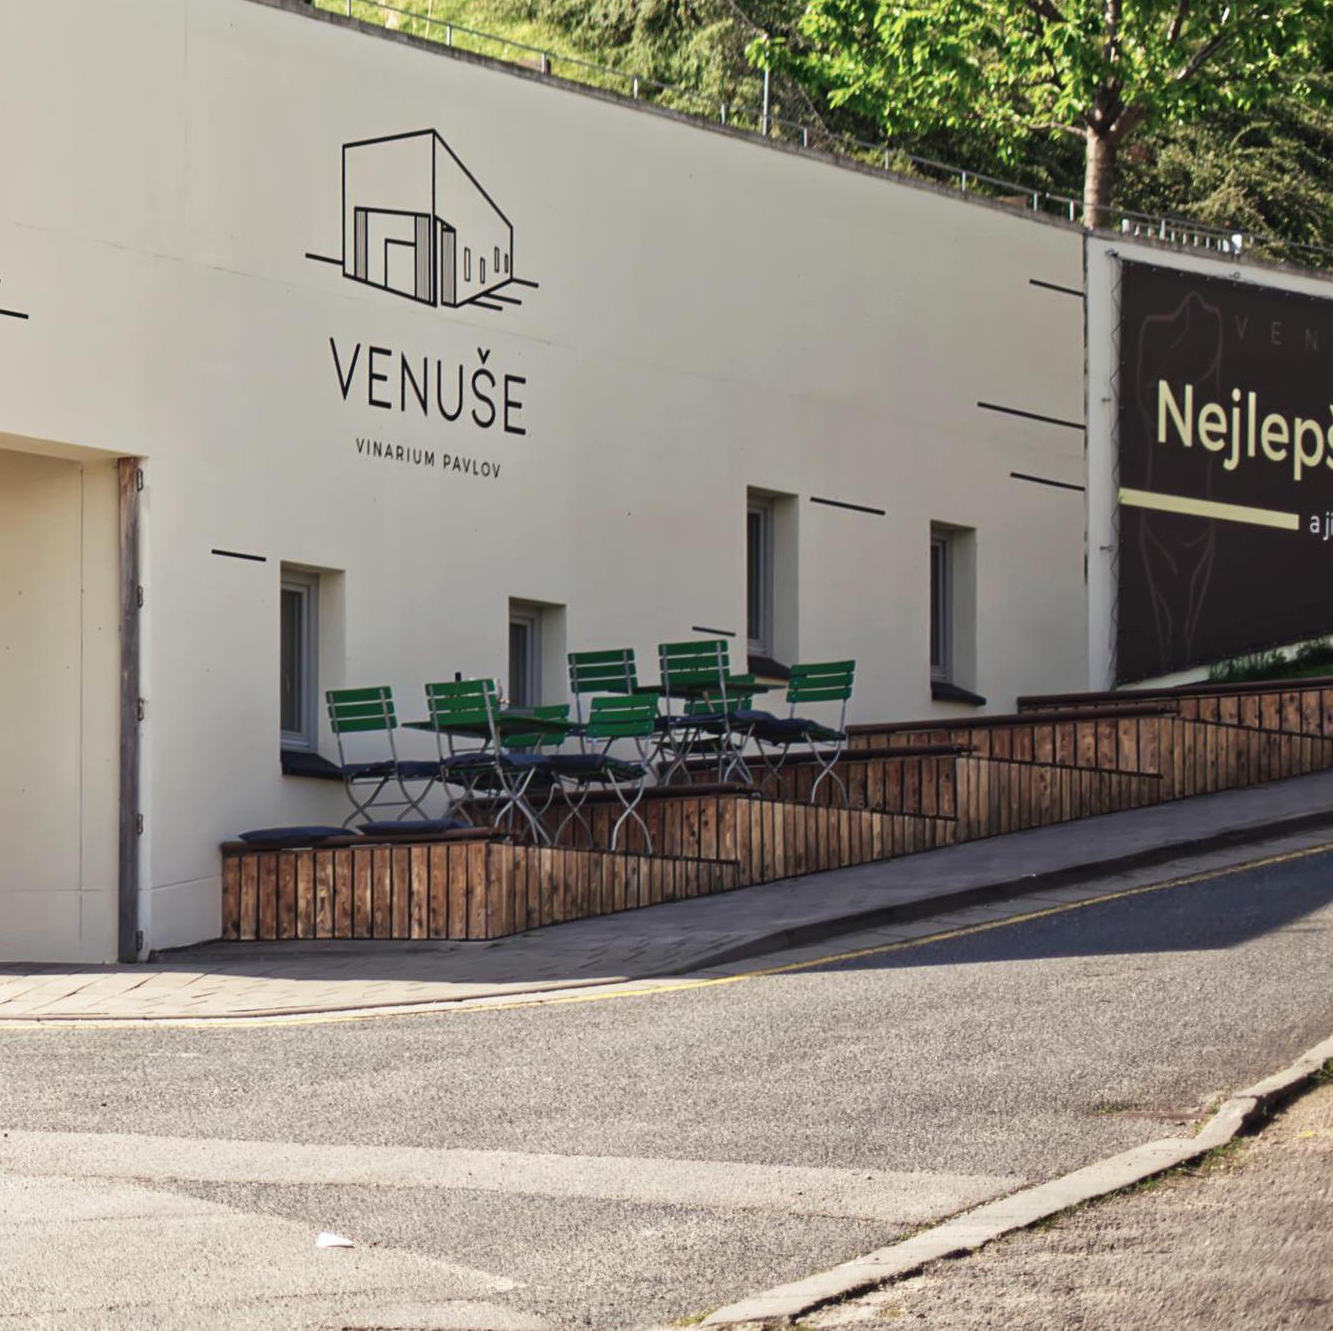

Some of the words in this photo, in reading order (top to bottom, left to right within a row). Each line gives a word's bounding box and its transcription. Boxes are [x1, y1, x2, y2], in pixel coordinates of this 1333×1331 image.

[329, 336, 526, 435] VENUŠE
[1157, 379, 1333, 481] Nejlep
[356, 438, 435, 467] VINARIUM
[443, 454, 501, 478] PAVLOV
